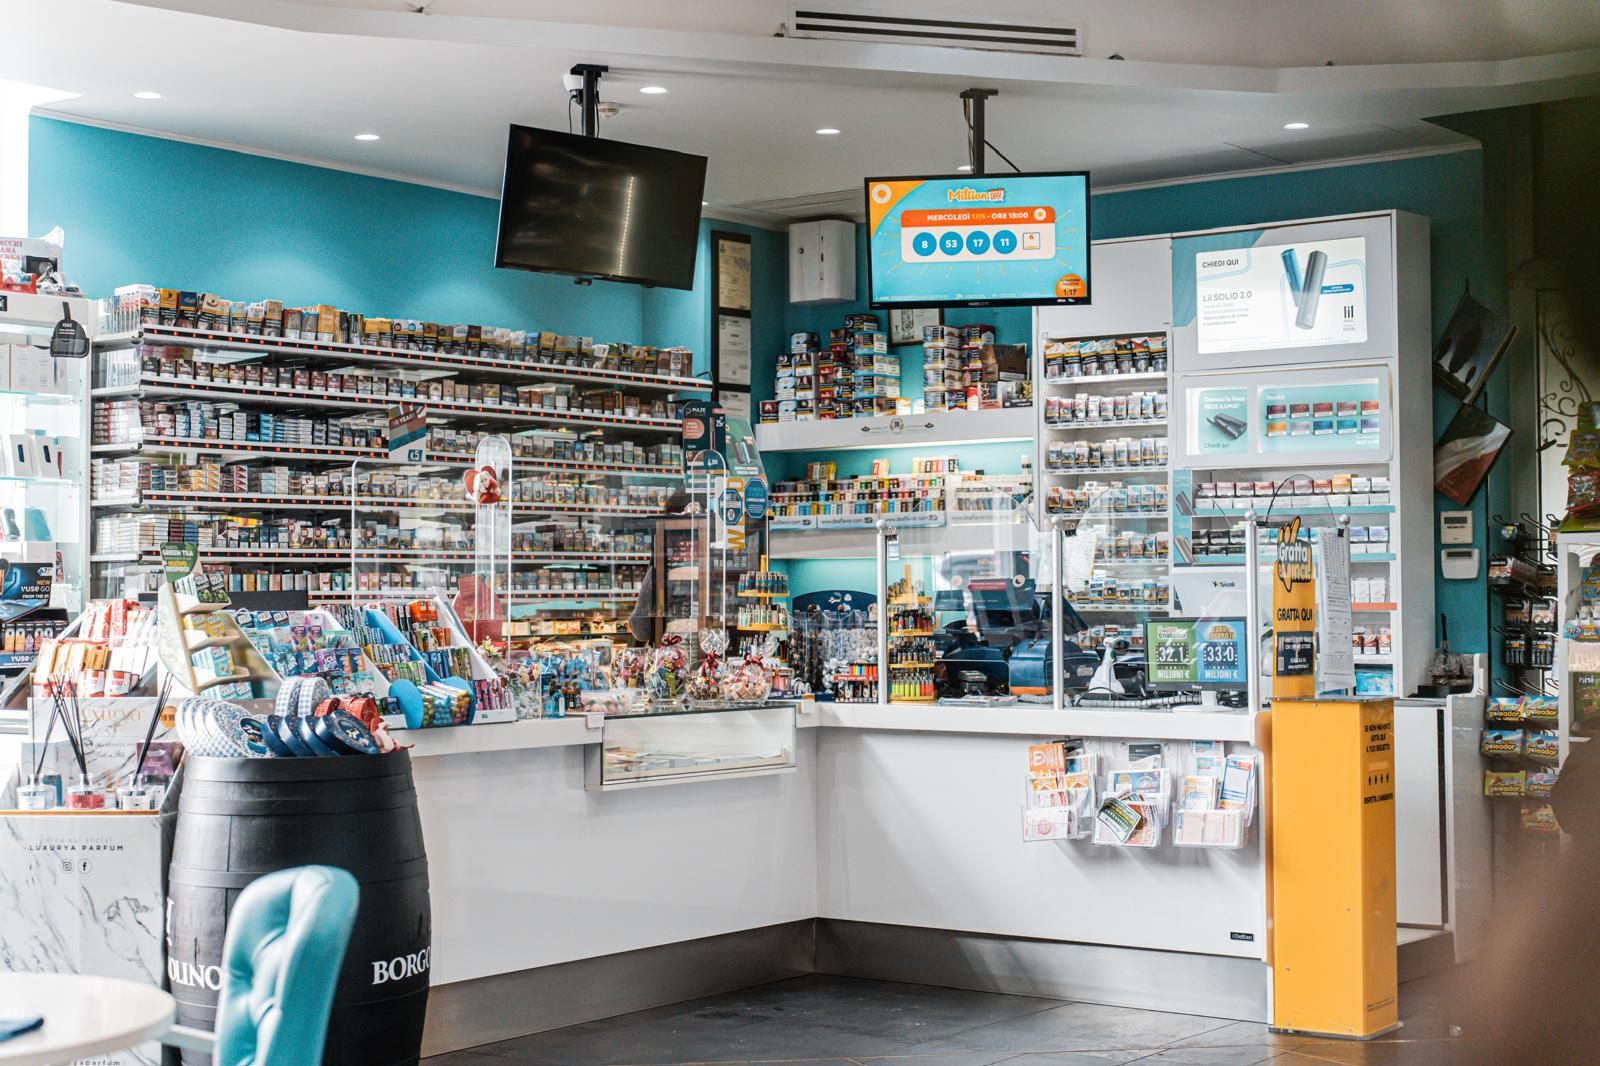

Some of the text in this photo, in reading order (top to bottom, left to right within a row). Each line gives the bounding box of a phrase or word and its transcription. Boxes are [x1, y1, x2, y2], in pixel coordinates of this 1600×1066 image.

[948, 187, 987, 202] Million
[927, 213, 971, 222] MERCOLEDÌ
[991, 212, 1007, 220] ORE
[1008, 211, 1029, 219] 13:00
[921, 241, 928, 249] 8
[945, 239, 958, 248] 53
[973, 239, 984, 247] 17
[1000, 238, 1010, 247] 11
[1202, 258, 1239, 269] CHIEDI QUI
[1213, 291, 1239, 302] SOLID
[1240, 290, 1253, 299] 2.0
[1343, 305, 1354, 319] lil
[1219, 580, 1235, 588] Sisal
[1277, 608, 1313, 621] GRATTA QUI
[1159, 646, 1184, 662] 32.1
[1207, 646, 1235, 662] 33.0
[1157, 669, 1190, 679] MILIONI €
[1204, 669, 1238, 680] MILIONI €
[1489, 710, 1520, 718] goleador
[1526, 708, 1558, 717] goleador
[1484, 743, 1516, 751] goleador
[1526, 746, 1558, 756] goleador
[1489, 785, 1521, 793] goleador
